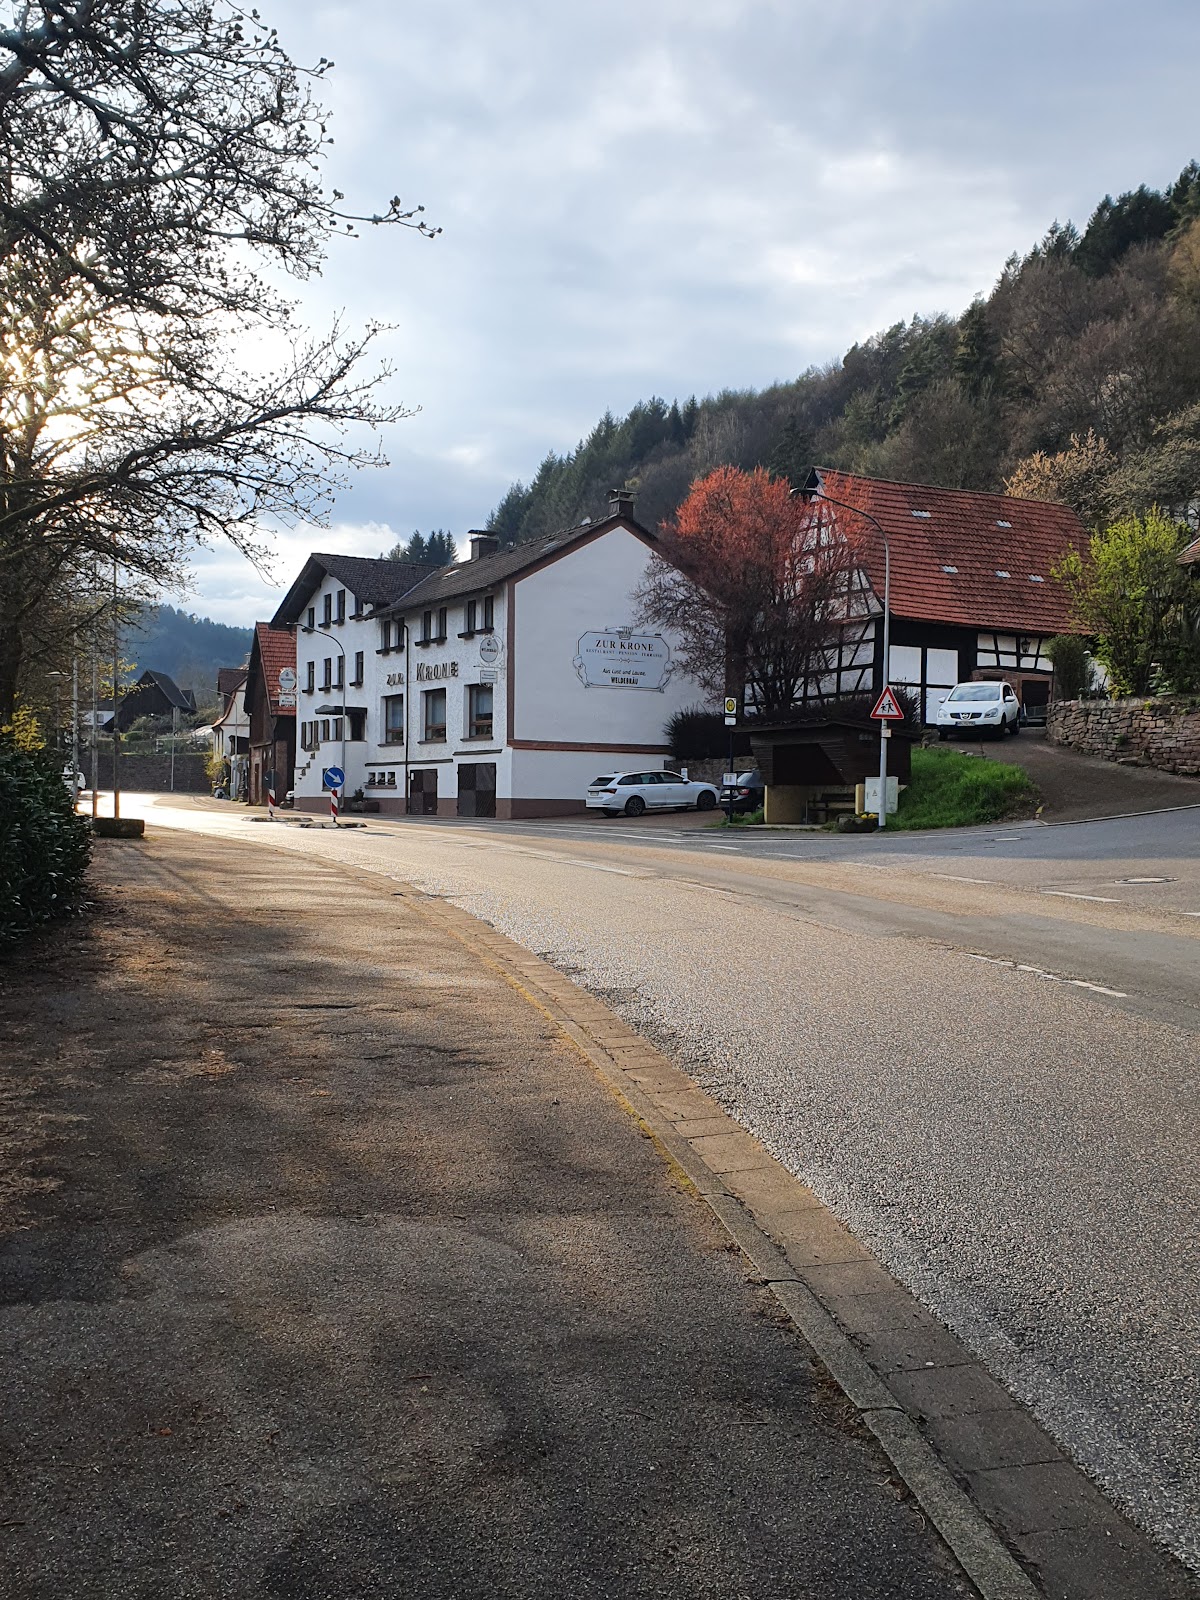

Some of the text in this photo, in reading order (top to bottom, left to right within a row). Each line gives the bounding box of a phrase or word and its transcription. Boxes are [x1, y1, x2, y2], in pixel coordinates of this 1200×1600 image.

[595, 640, 654, 651] ZUR KRONE
[416, 661, 458, 681] KRONE
